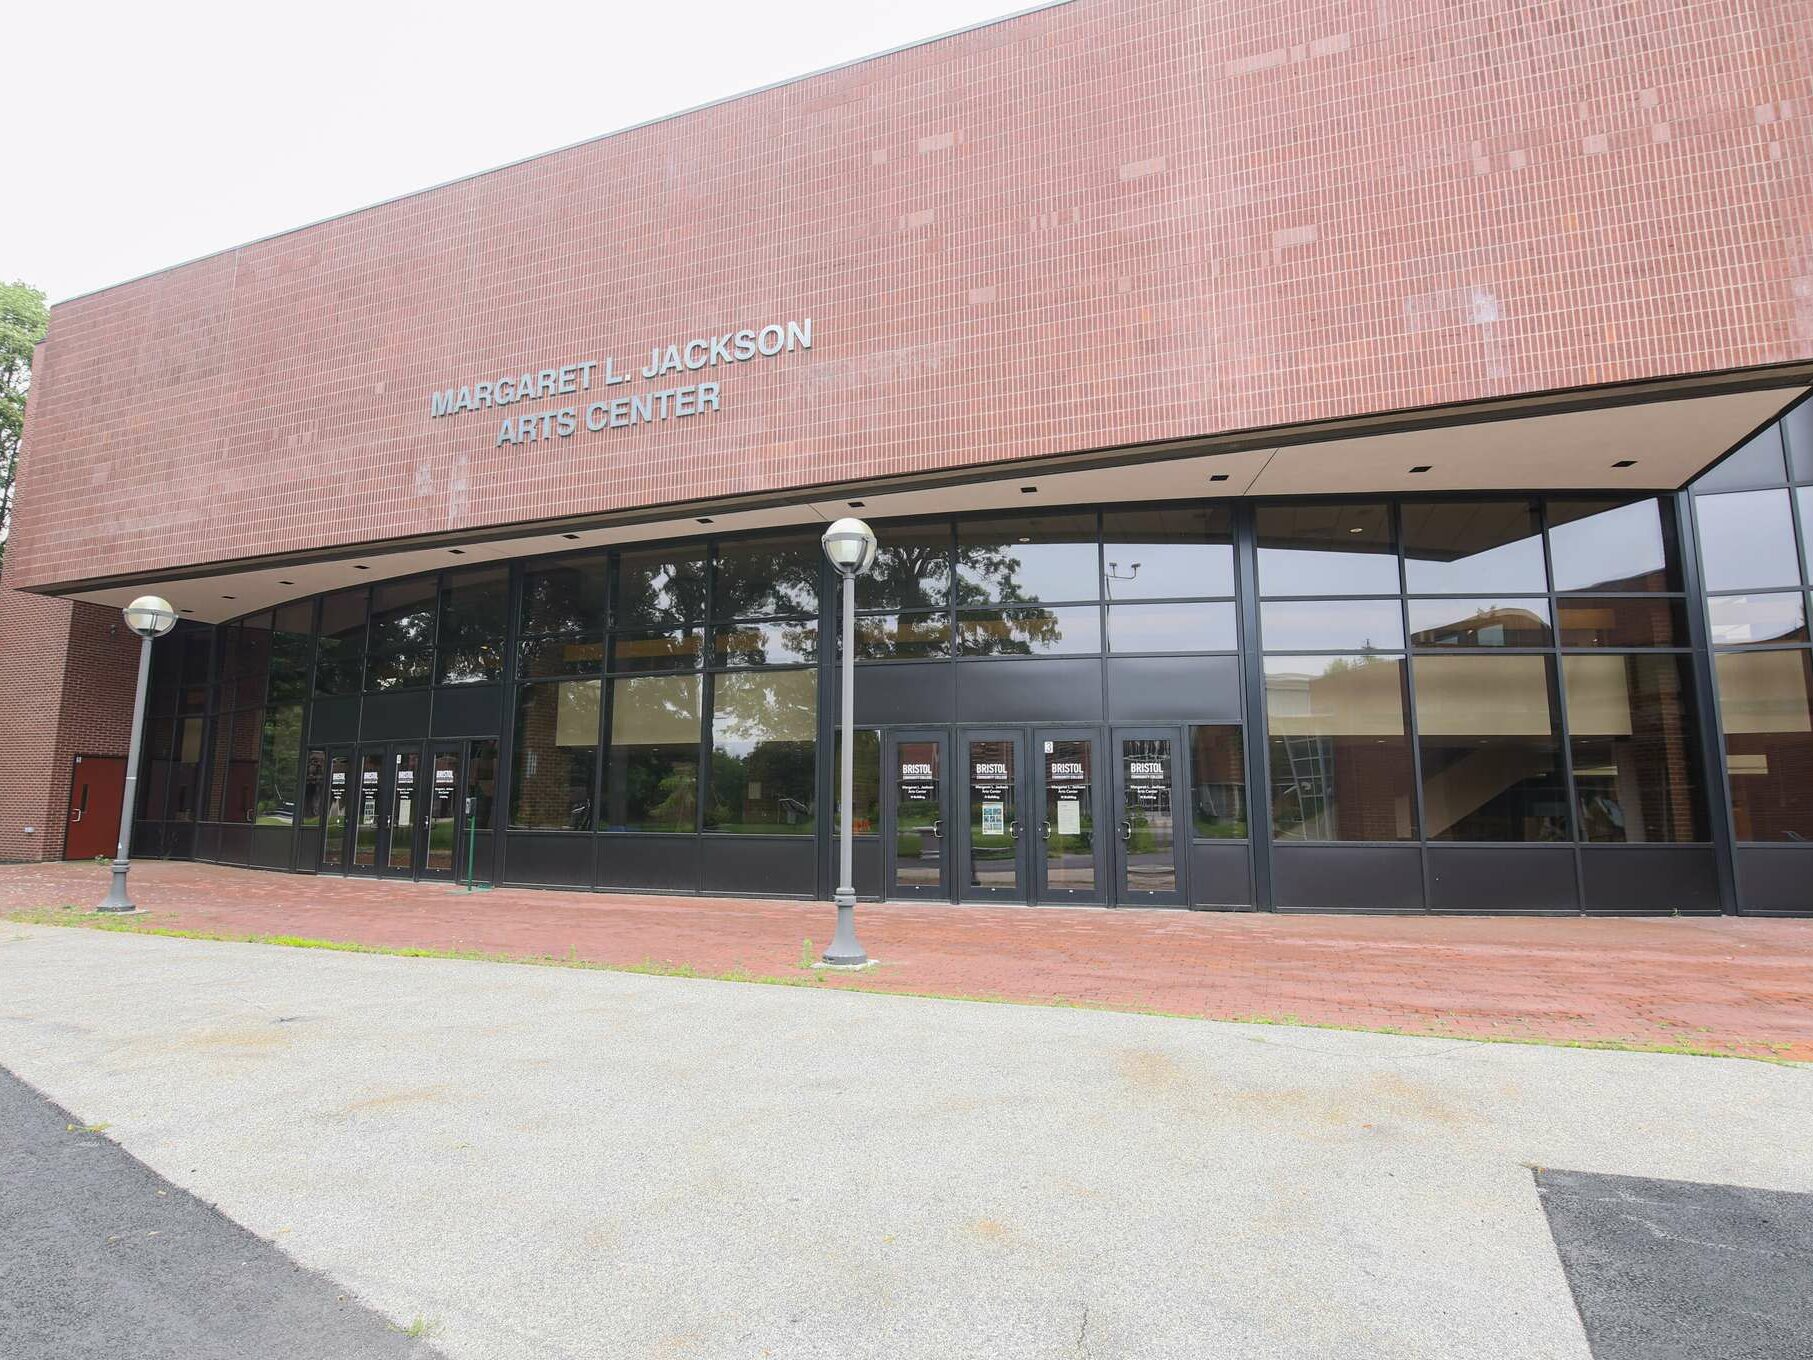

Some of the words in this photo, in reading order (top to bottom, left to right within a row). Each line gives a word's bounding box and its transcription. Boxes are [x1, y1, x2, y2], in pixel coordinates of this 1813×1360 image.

[430, 360, 596, 418] MARGARET
[605, 356, 631, 386] L.
[643, 318, 812, 379] JACKSON
[497, 406, 577, 447] ARTS
[586, 382, 720, 432] CENTER
[903, 764, 932, 774] BRISTOL
[977, 764, 1007, 774] BRISTOL
[1052, 763, 1084, 773] BRISTOL
[1131, 763, 1164, 773] BRISTOL
